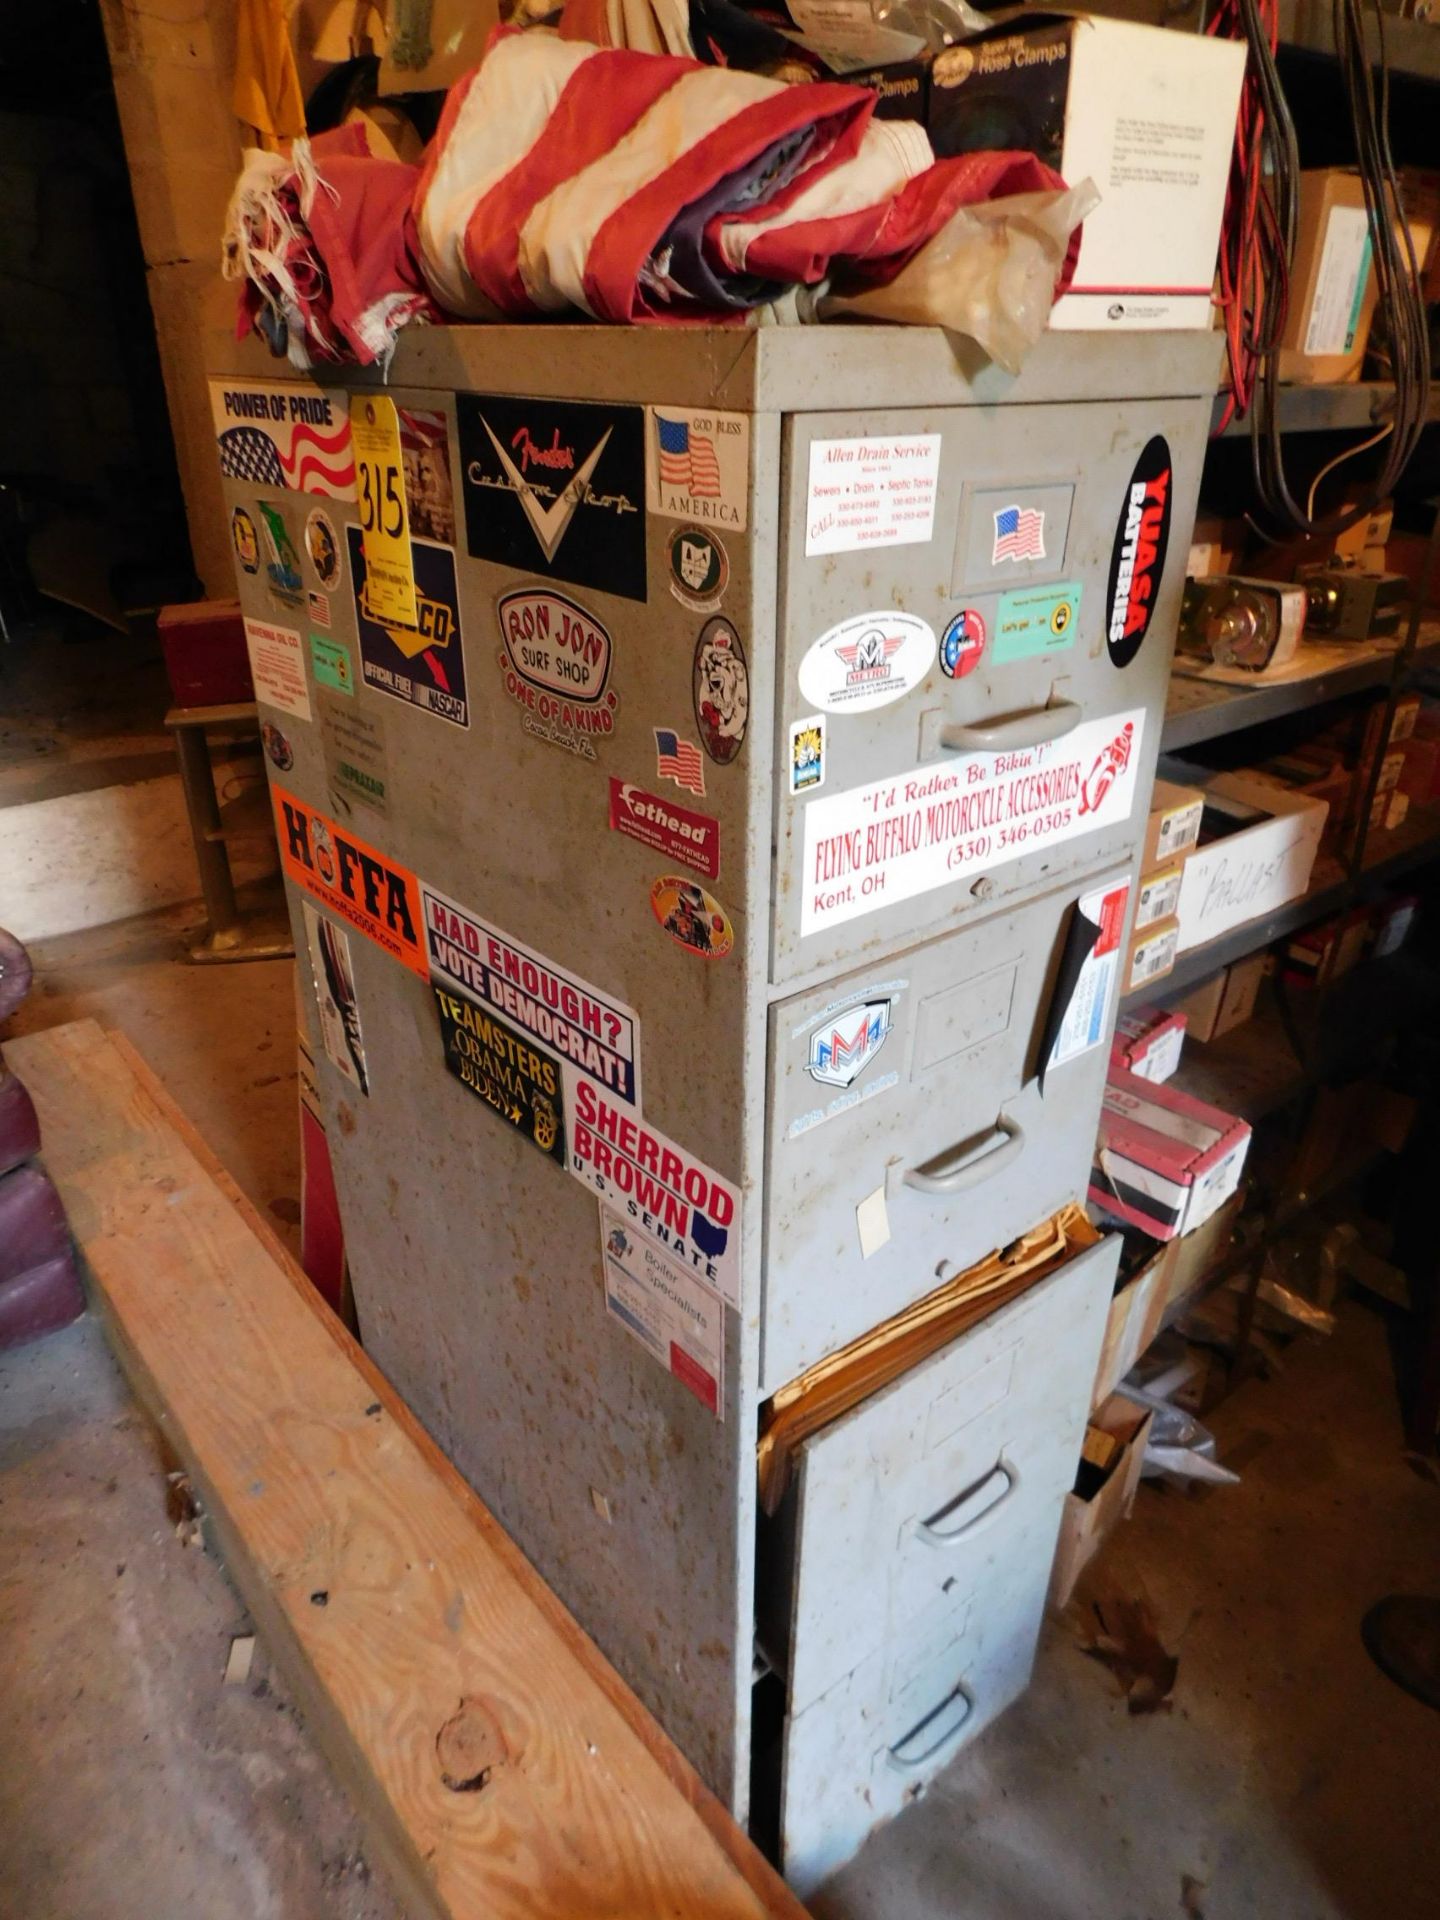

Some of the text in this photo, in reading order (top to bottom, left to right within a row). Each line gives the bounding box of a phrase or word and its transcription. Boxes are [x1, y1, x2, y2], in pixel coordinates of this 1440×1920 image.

[979, 55, 1012, 75] Hose
[1014, 42, 1067, 67] Clamps
[224, 391, 333, 427] POWER OF PRIDE
[692, 418, 742, 435] GOD BLESS
[824, 444, 932, 464] Allen Drain Service
[359, 462, 404, 539] 315
[668, 496, 741, 523] AMERICA
[813, 478, 933, 498] Sewers Drain Septic Tanks
[811, 512, 836, 540] CALL
[1123, 469, 1170, 638] YUASA
[1110, 481, 1147, 643] BATTERIES
[509, 604, 602, 667] RON JON
[364, 661, 394, 687] OFFICIAL
[394, 671, 412, 693] FUEL
[520, 646, 590, 686] SURF SHOP
[848, 667, 888, 683] METRO
[429, 690, 462, 717] NASCAR
[539, 698, 559, 722] OF
[562, 704, 574, 729] A
[903, 776, 959, 806] Rather
[966, 763, 987, 782] Be
[814, 761, 1082, 885] FLYING BUFFALO MOTORCYCLE ACCESSORIES
[947, 807, 1071, 870] (330) 346-0305
[282, 800, 418, 947] HOFFA
[814, 871, 886, 914] Kent, OH
[306, 877, 403, 956] www.hoffa2006.com
[432, 902, 623, 1048] HAD ENOUGH?
[434, 935, 628, 1095] VOTE DEMOCRAT!
[435, 988, 556, 1096] TEAMSTERS
[455, 1029, 528, 1103] OBAMA
[459, 1058, 510, 1115] BIDEN
[574, 1121, 689, 1239] BROWN
[575, 1080, 734, 1227] SHERROD
[573, 1155, 718, 1283] U.S. SENATE
[644, 1249, 678, 1284] Boiler
[647, 1267, 708, 1330] Specialists
